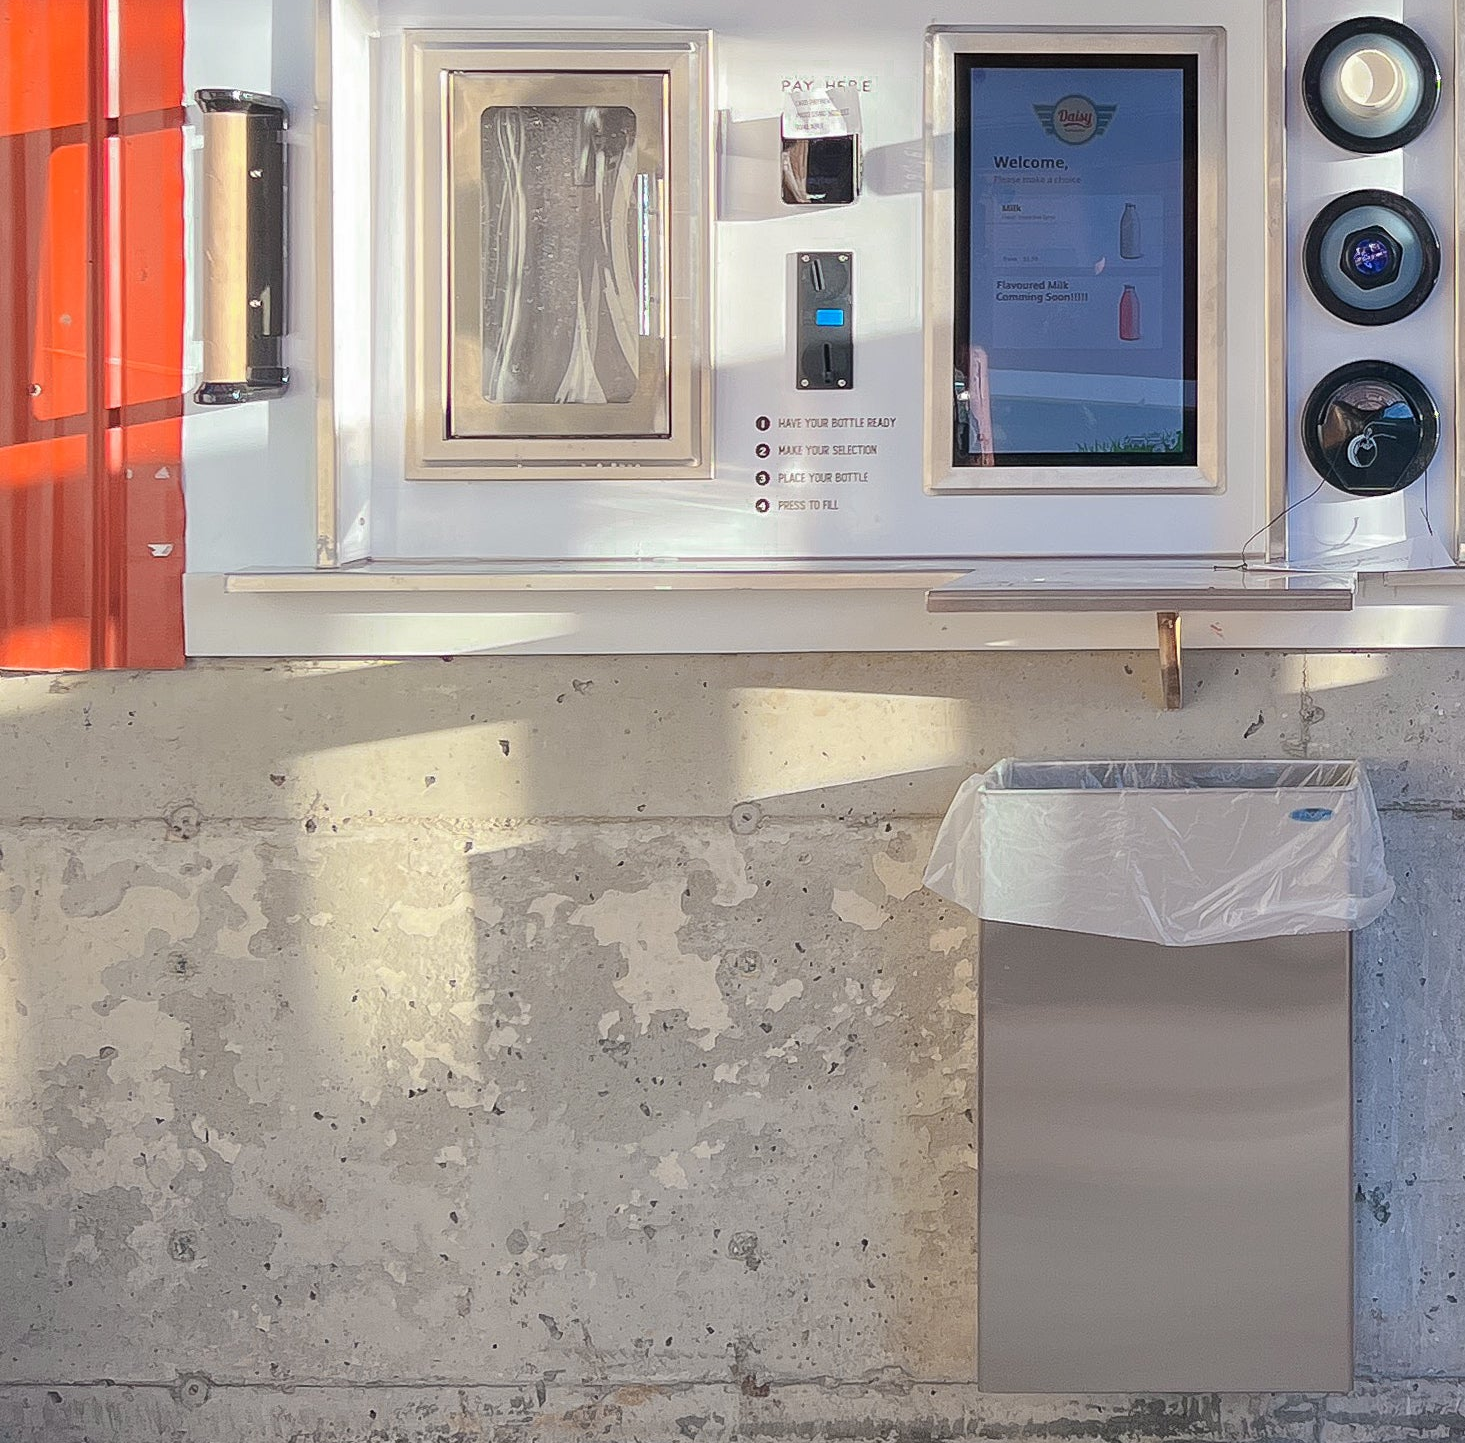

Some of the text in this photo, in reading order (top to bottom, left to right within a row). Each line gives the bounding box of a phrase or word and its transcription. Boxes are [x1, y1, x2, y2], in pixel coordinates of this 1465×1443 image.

[782, 80, 815, 92] PAY
[1058, 109, 1093, 127] Daisy
[993, 155, 1068, 172] Welcome,
[1002, 204, 1021, 212] Milk
[996, 280, 1069, 291] Flavoured Milk
[996, 292, 1043, 304] Comming
[778, 418, 802, 428] HAVE
[805, 418, 829, 428] YOUR
[831, 418, 865, 428] BOTTLE
[867, 417, 897, 428] READY
[778, 445, 802, 455] MAKE
[805, 445, 829, 455] YOUR
[832, 445, 878, 455] SELECTION
[778, 473, 805, 483] PLACE
[808, 472, 832, 483] YOUR
[835, 472, 869, 482] BOTTLE
[778, 500, 806, 510] PRESS
[808, 500, 821, 510] TO
[822, 500, 839, 510] FILL
